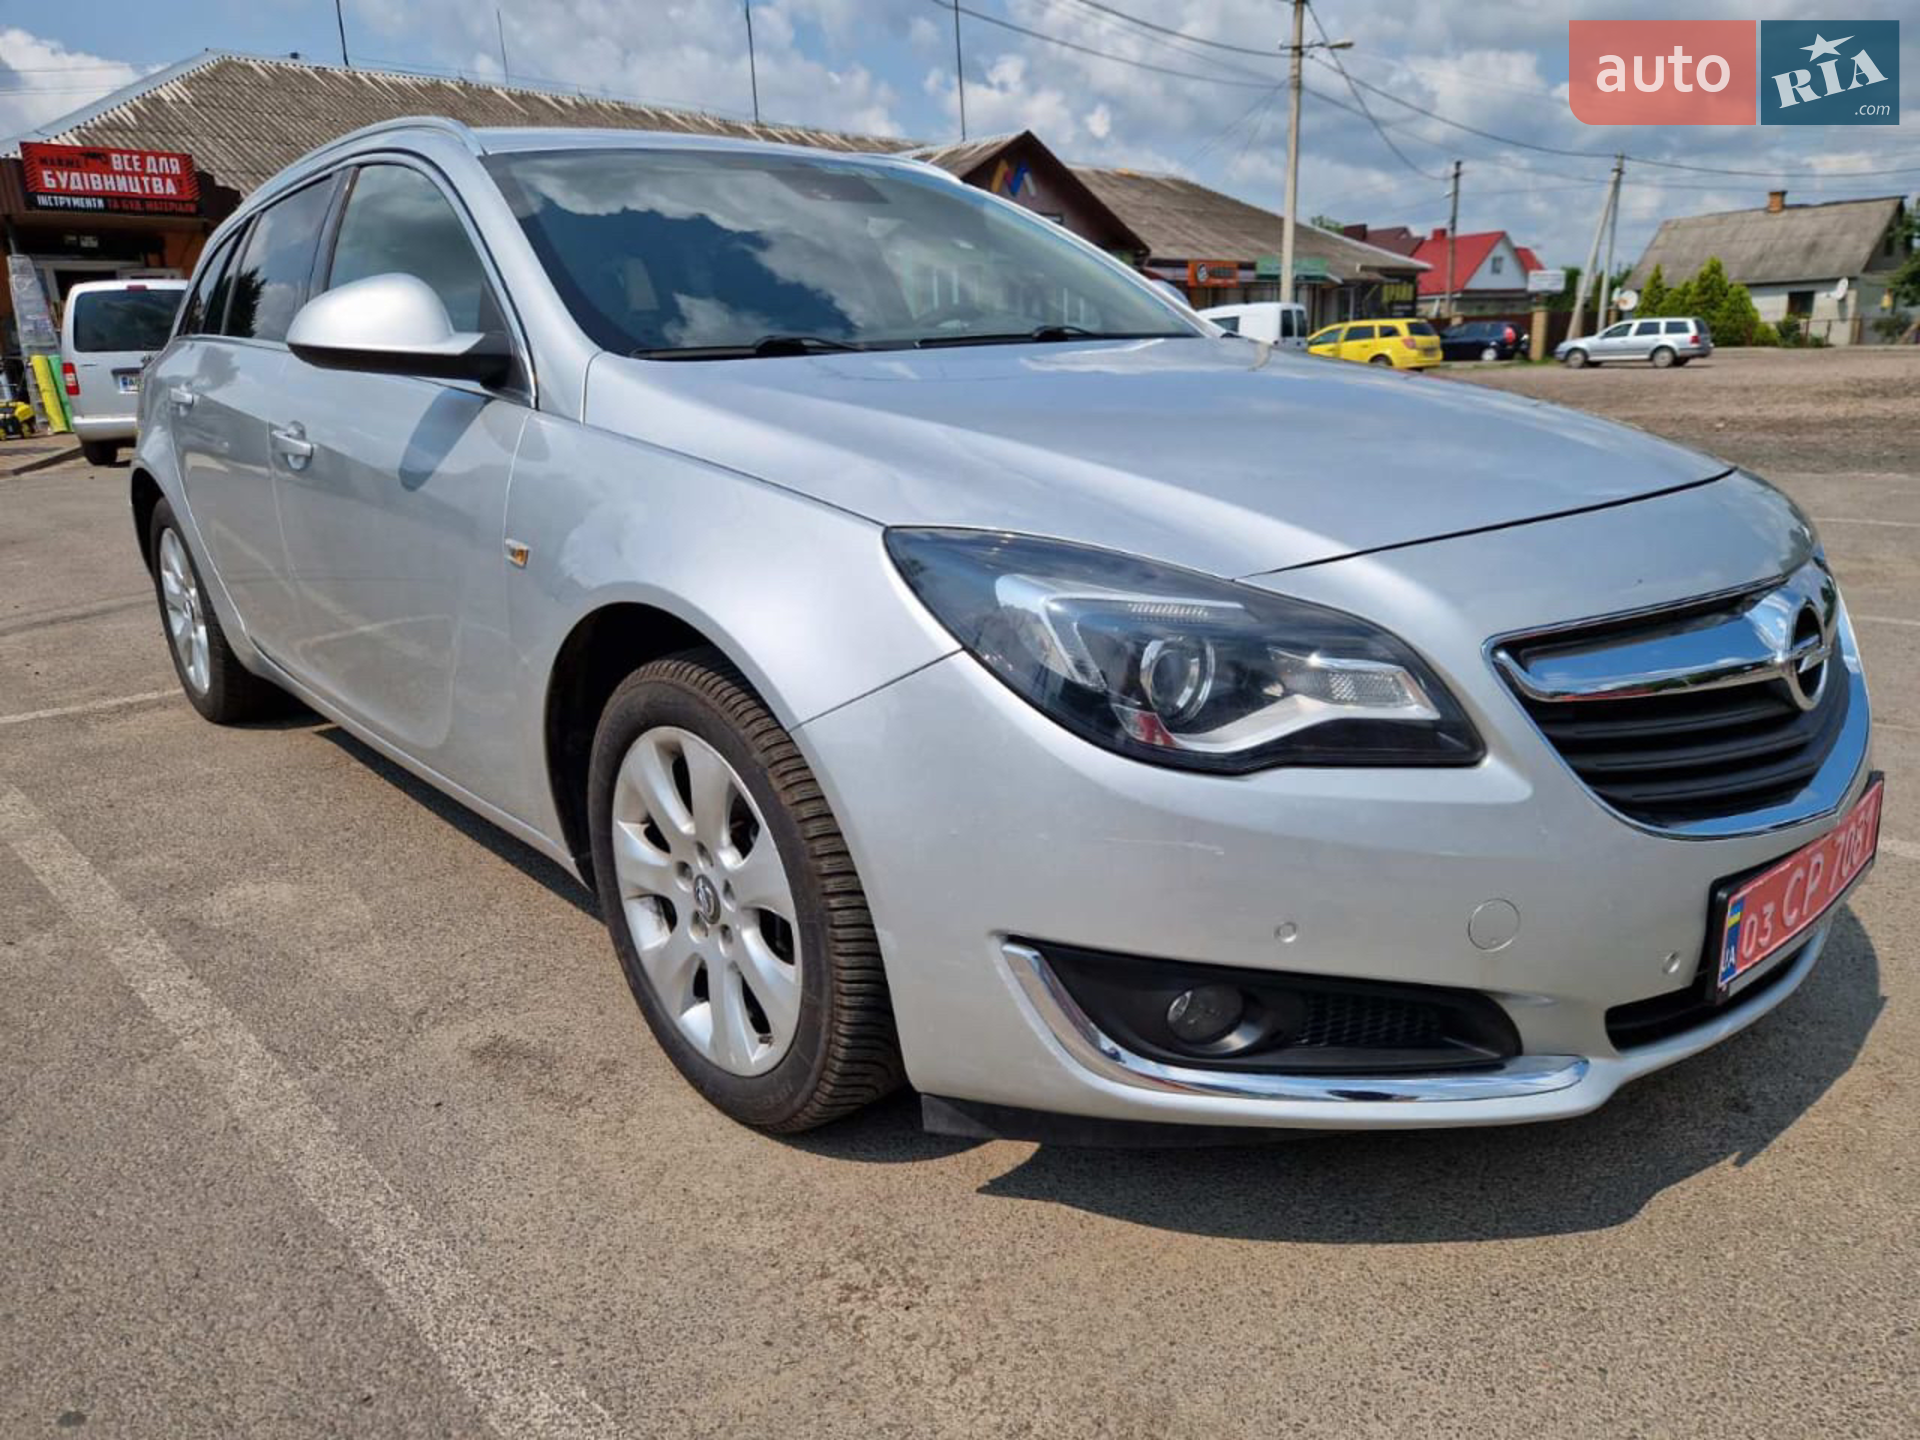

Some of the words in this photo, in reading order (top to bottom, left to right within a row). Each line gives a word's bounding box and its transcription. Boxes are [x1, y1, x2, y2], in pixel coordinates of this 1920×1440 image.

[111, 153, 143, 172] ВСЕ
[146, 155, 181, 175] ДЛЯ
[42, 169, 178, 195] БУДІВНИЦТВА
[36, 194, 105, 209] ІНСТРУМЕНТИ
[1741, 901, 1776, 959] 03
